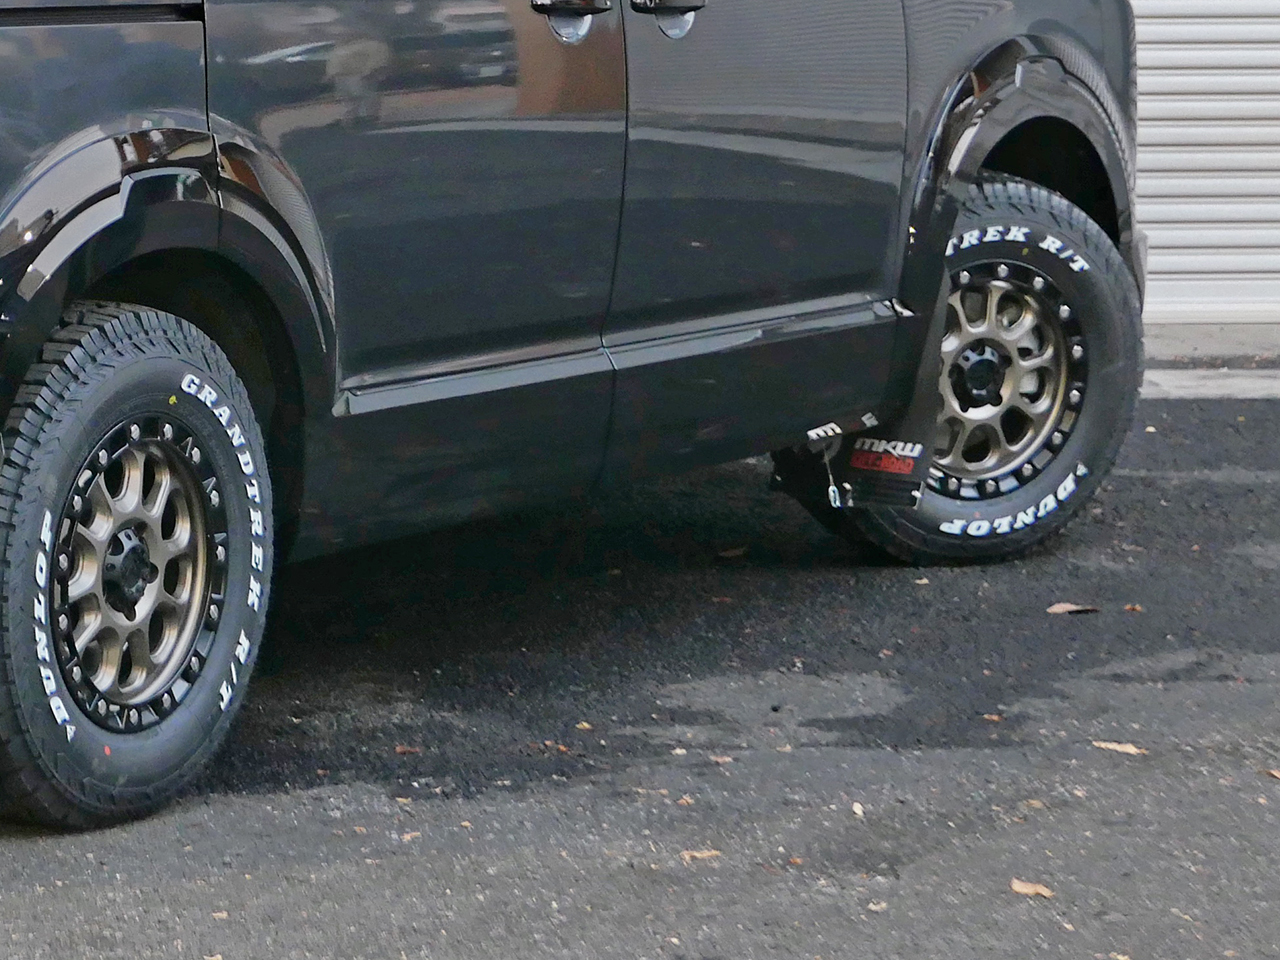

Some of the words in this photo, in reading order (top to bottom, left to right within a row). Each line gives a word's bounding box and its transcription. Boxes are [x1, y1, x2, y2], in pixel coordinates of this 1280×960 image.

[1038, 235, 1091, 273] R/T
[180, 373, 264, 613] GRANDTREK
[938, 472, 1078, 537] DUNLOP
[34, 509, 70, 726] DUNLOP
